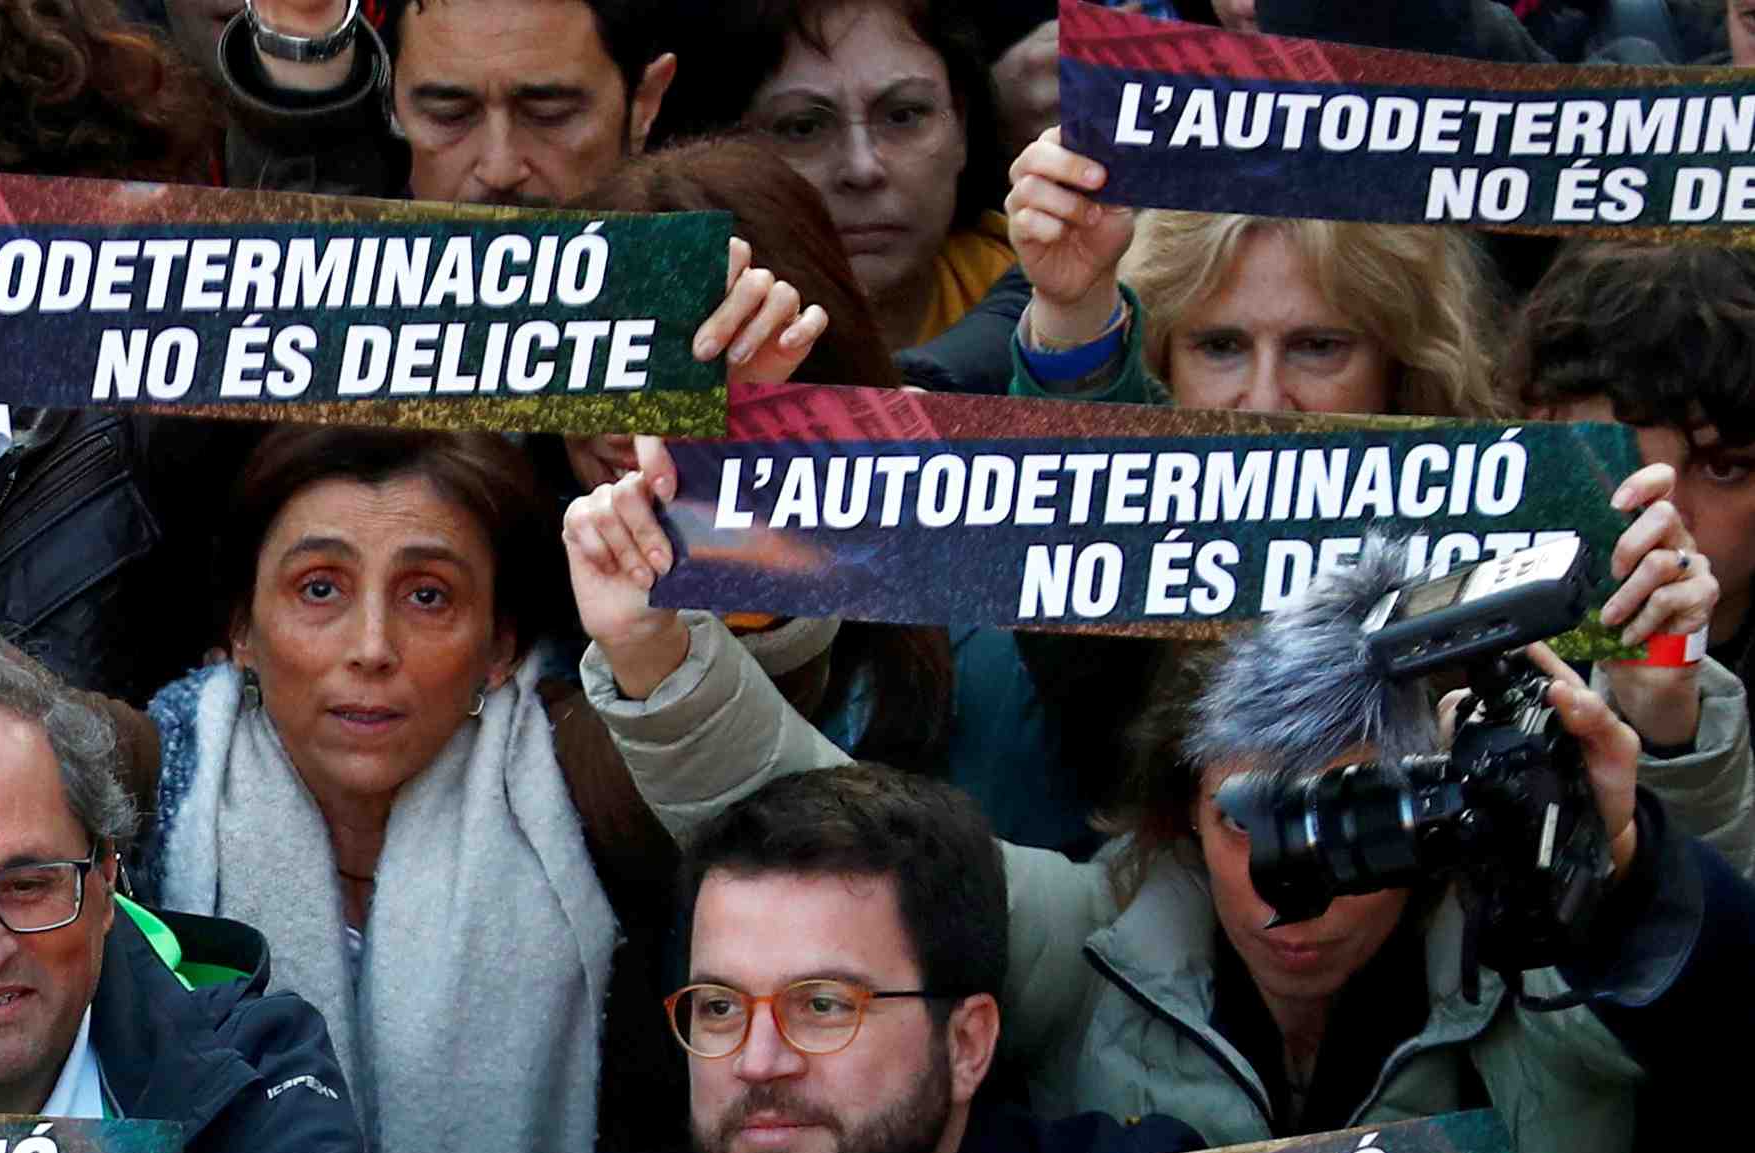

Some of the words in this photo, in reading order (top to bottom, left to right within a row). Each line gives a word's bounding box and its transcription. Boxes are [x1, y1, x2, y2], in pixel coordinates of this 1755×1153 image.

[1114, 82, 1755, 155] L'AUTODETERMIN
[1424, 167, 1530, 221] NO
[1552, 157, 1648, 222] ÉS
[91, 327, 199, 400] NO
[219, 313, 318, 397] ÉS
[337, 319, 656, 395] DELICTE
[714, 427, 1527, 529] L'AUTODETERMINACIÓ
[1018, 541, 1123, 618] NO
[1144, 528, 1240, 616] ÉS
